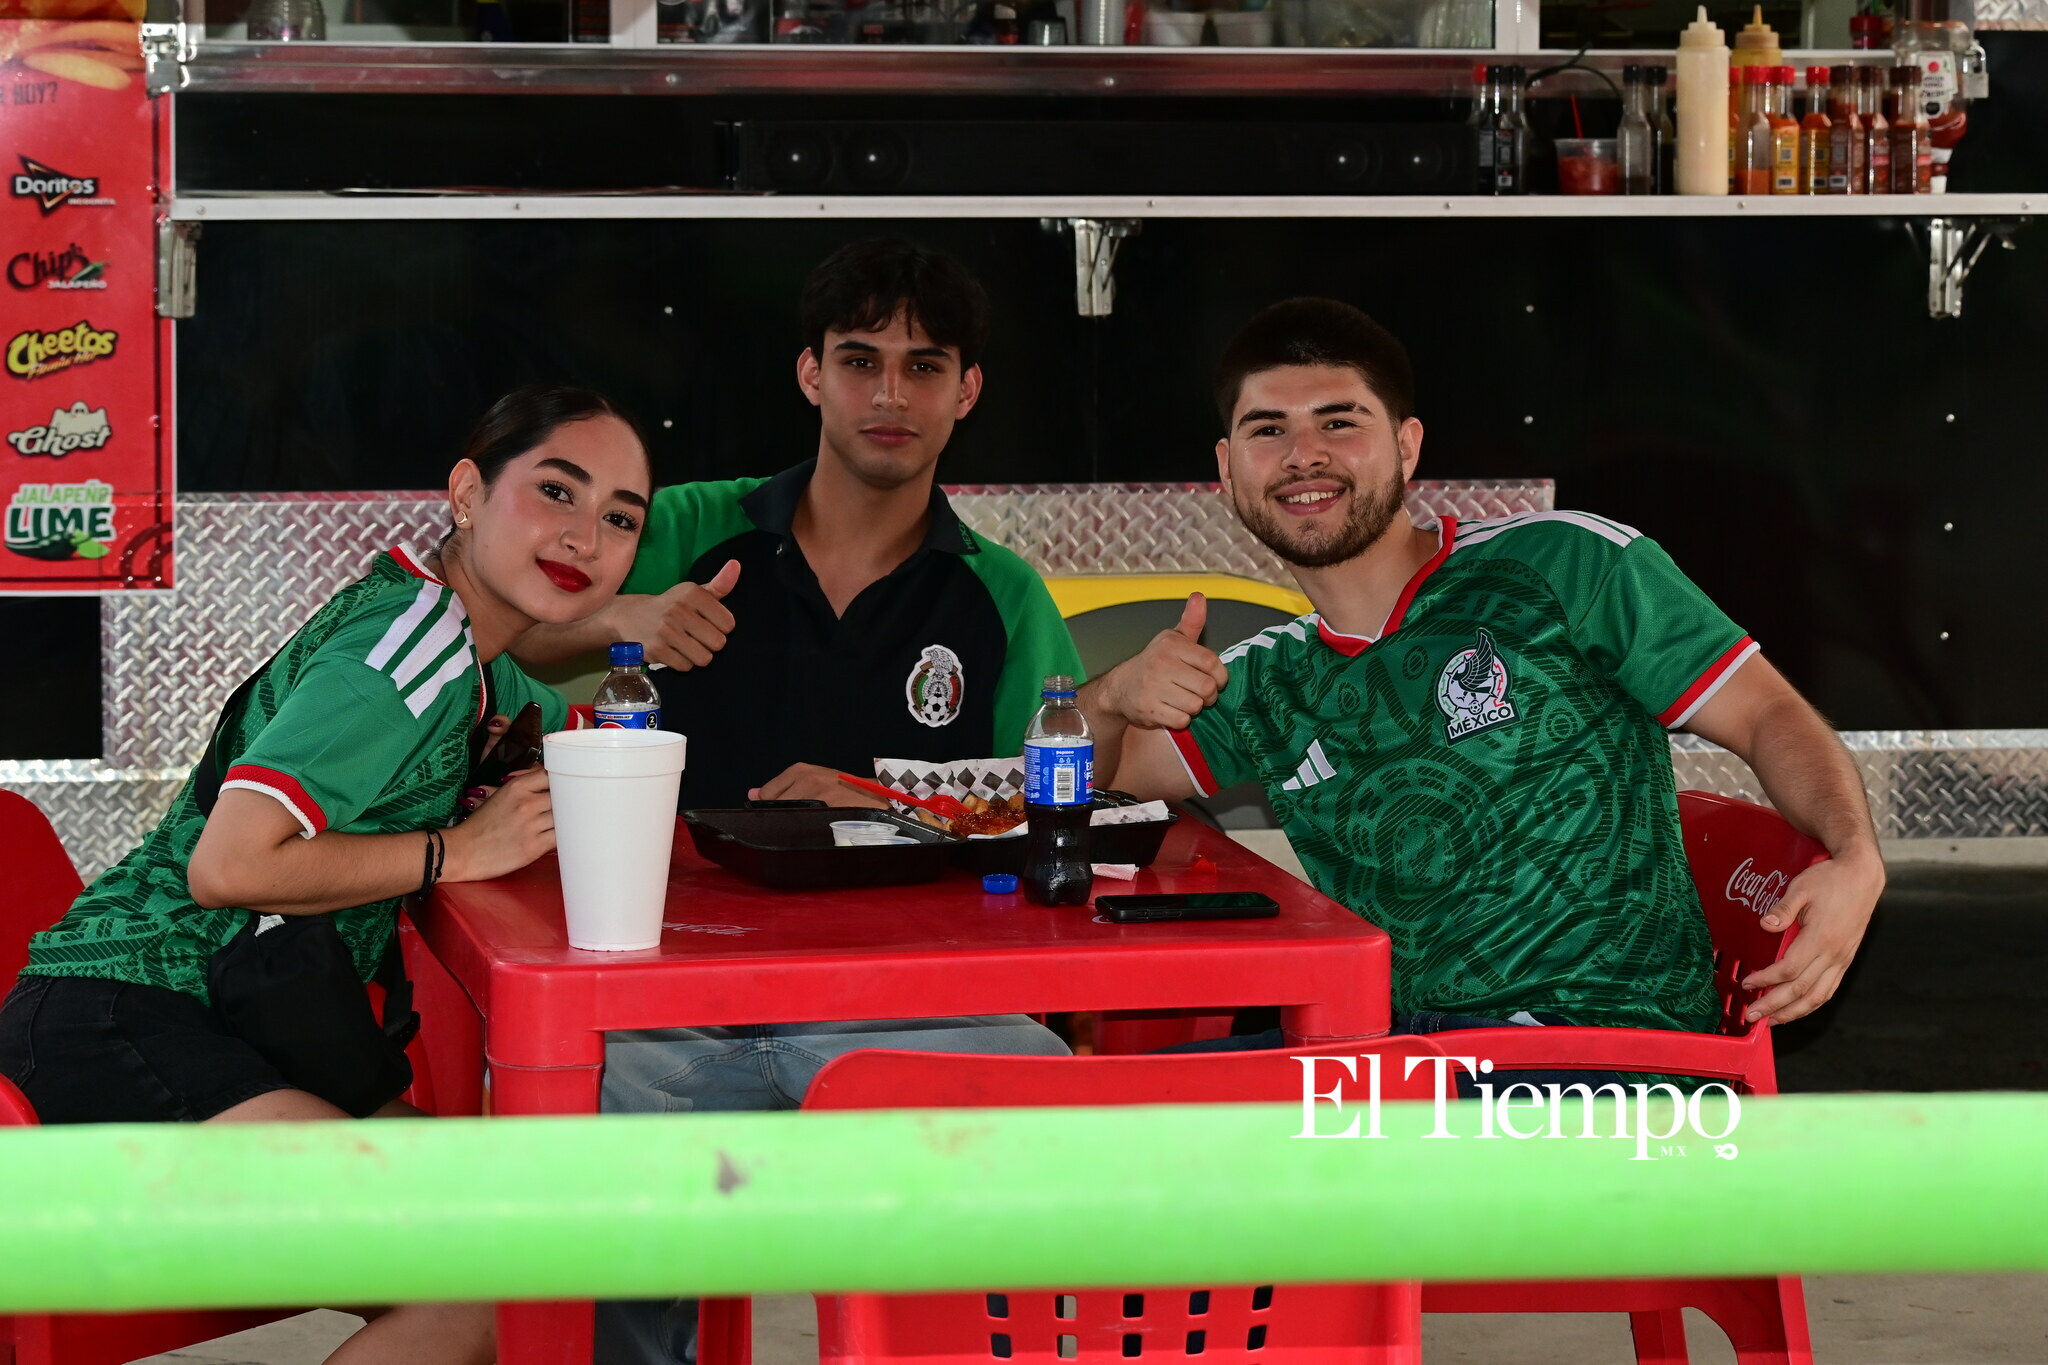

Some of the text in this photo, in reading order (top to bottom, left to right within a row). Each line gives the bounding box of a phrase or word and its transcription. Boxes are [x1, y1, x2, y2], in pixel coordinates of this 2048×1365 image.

[13, 81, 58, 106] HOY?
[15, 175, 96, 195] Doritos
[6, 321, 116, 375] Cheetos
[7, 425, 111, 457] Ghost
[15, 483, 110, 505] JALAPEÑO
[9, 506, 112, 539] LIME
[649, 715, 655, 723] 2
[1449, 705, 1512, 738] MÉXICO
